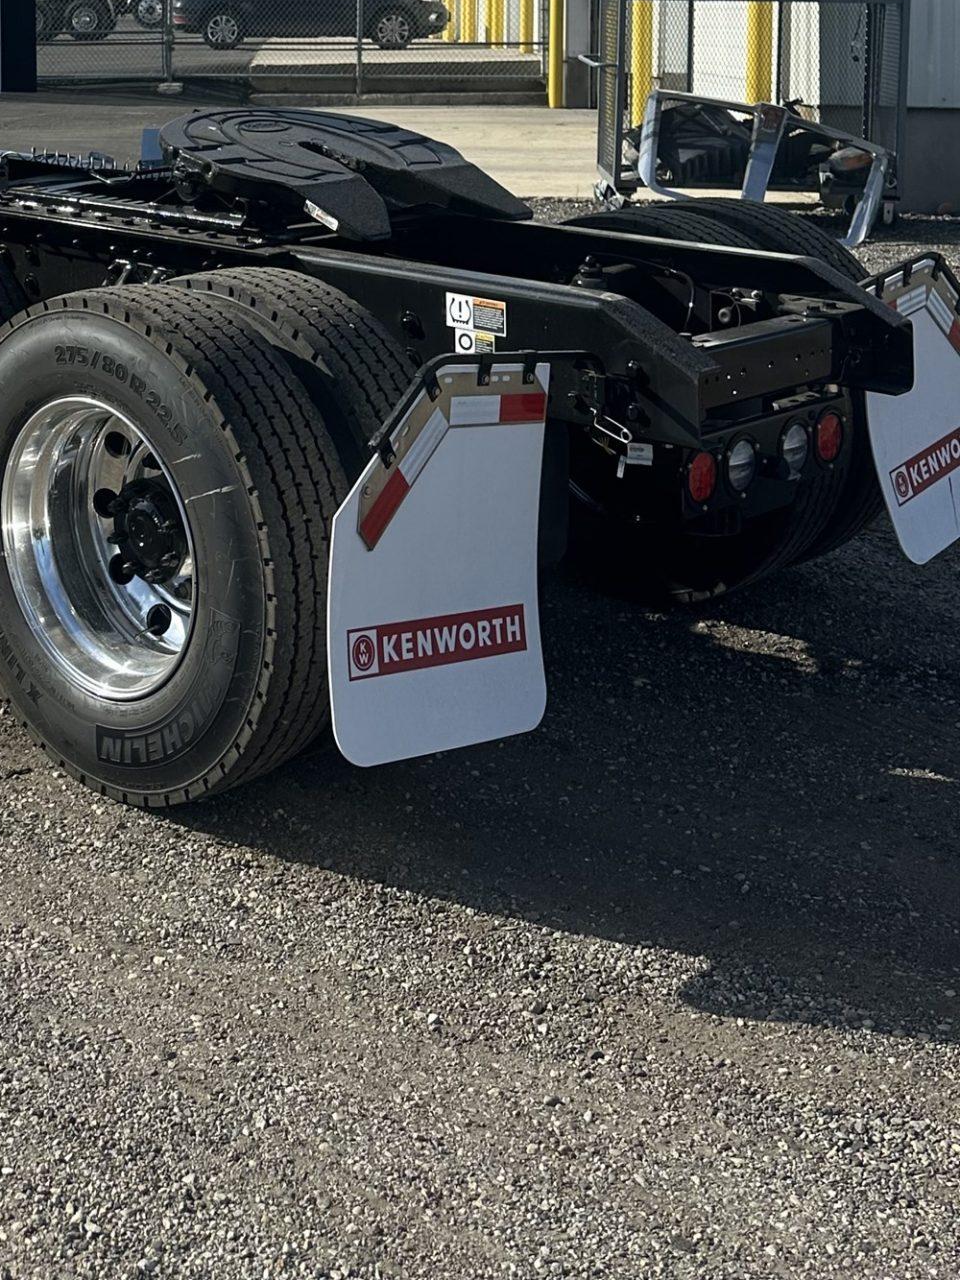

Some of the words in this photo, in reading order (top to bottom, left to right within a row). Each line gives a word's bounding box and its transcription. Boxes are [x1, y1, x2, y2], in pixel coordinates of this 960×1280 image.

[909, 438, 960, 487] KENWO
[382, 614, 522, 664] KENWORTH
[100, 687, 222, 764] MICHELIN
